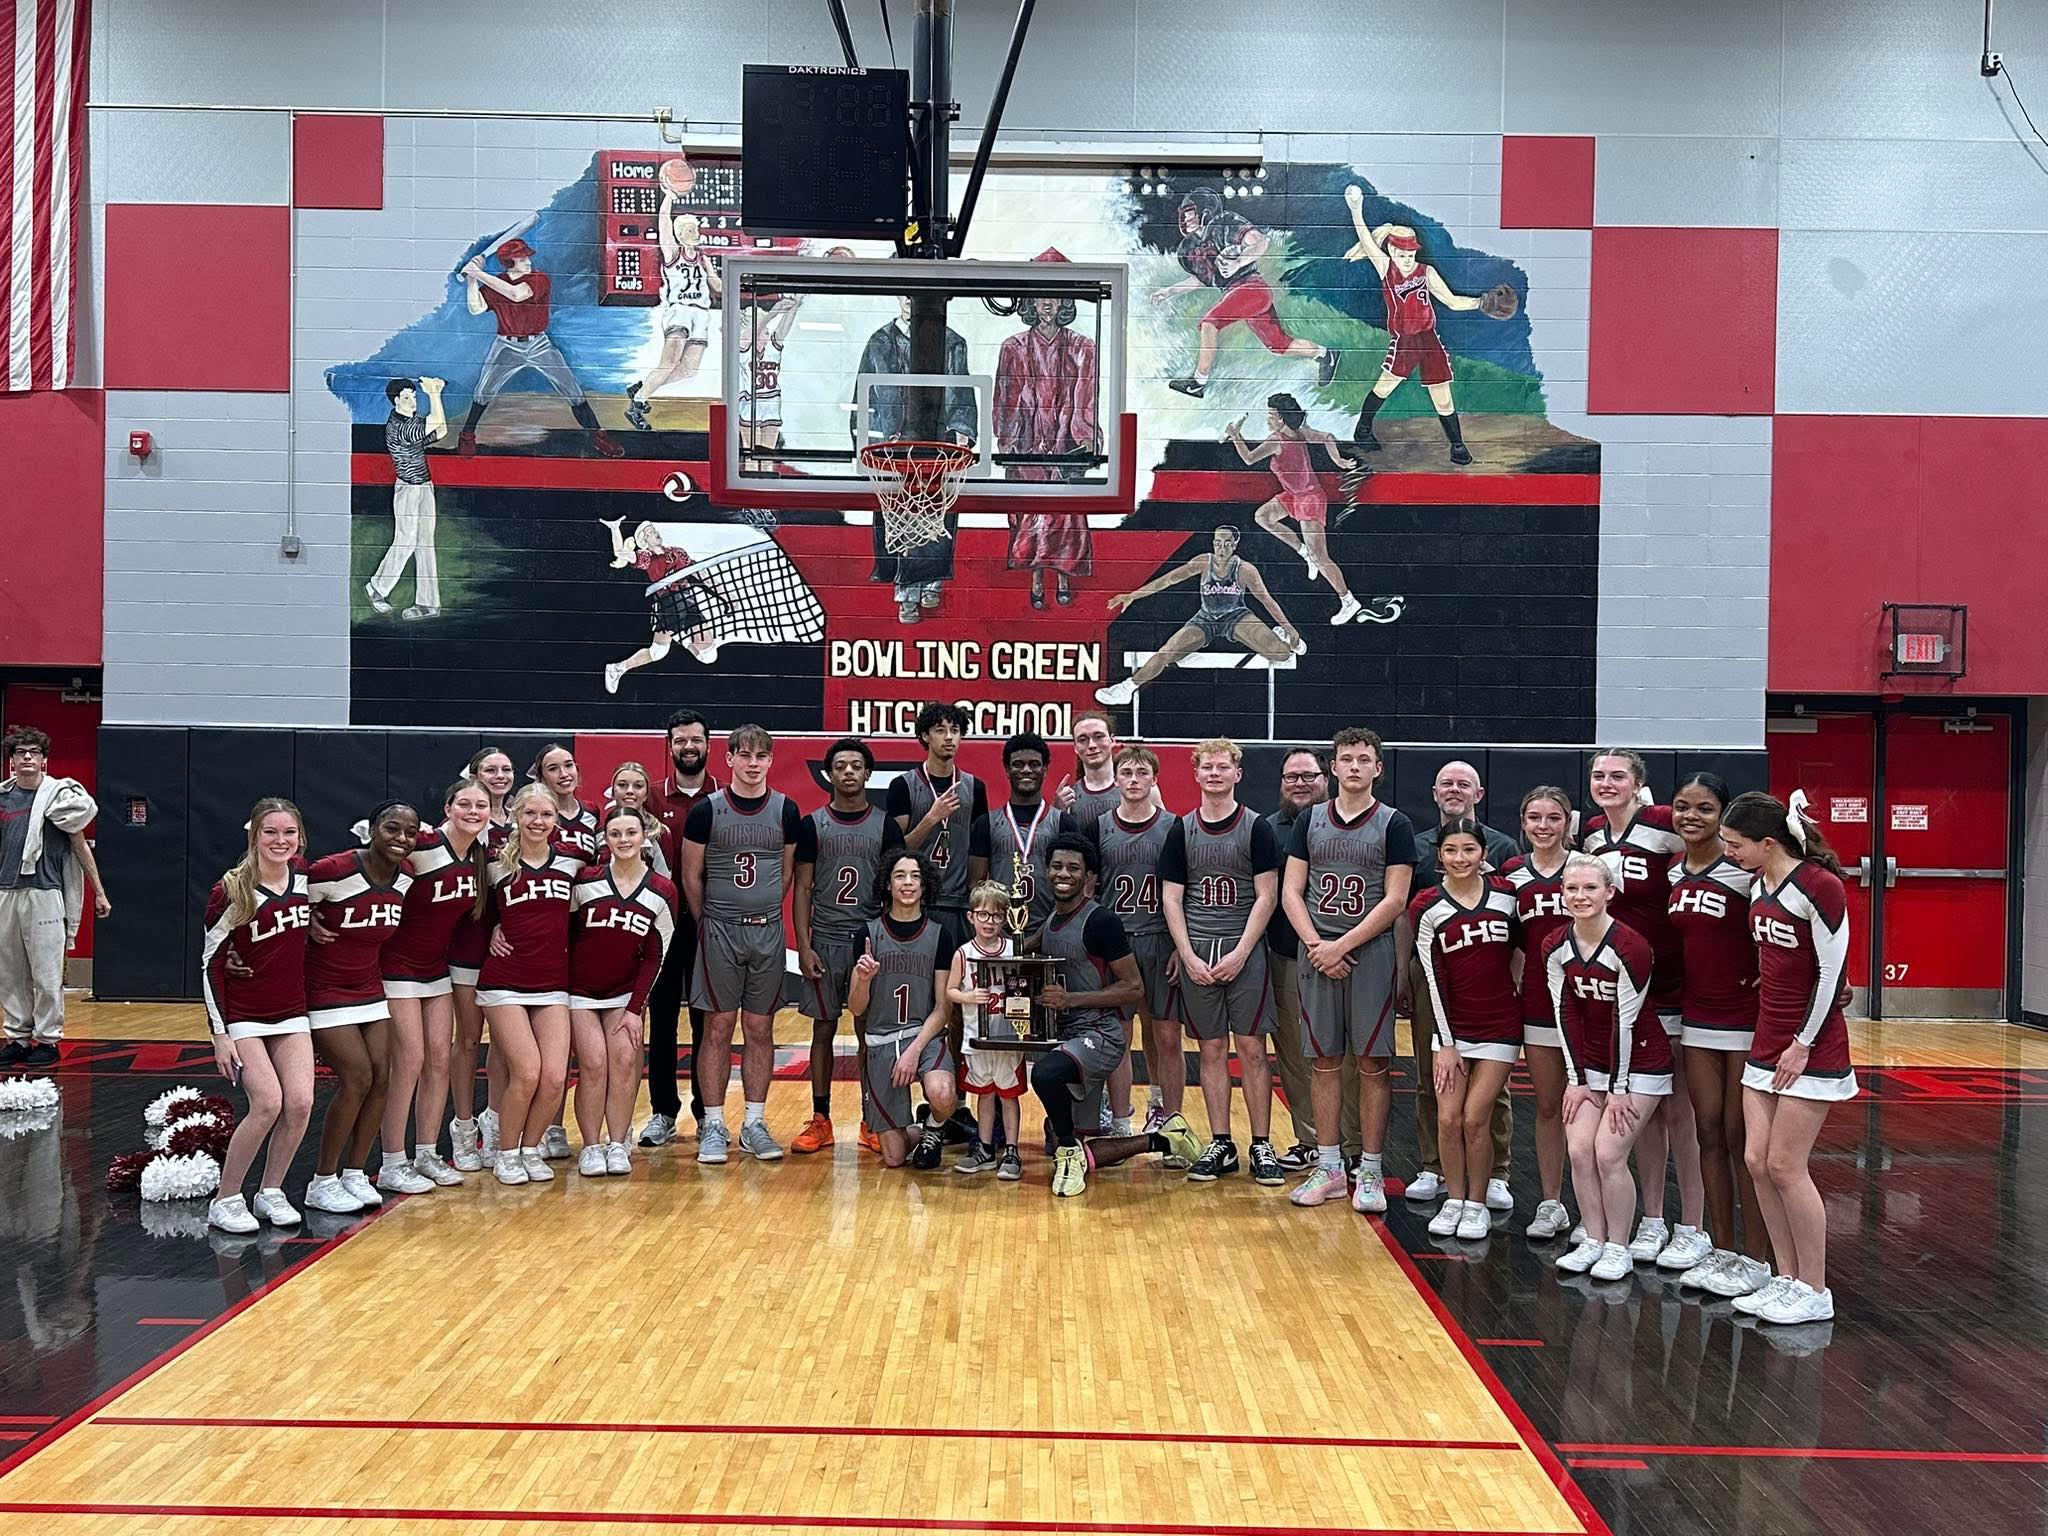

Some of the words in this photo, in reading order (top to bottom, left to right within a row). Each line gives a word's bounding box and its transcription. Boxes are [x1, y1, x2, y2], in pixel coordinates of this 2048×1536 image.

[788, 65, 867, 76] DAKTRONICS
[611, 162, 654, 179] Home
[700, 216, 710, 228] 2
[717, 216, 727, 229] 3
[615, 276, 643, 291] Fouls
[680, 265, 703, 293] 34
[1416, 289, 1429, 306] 9
[830, 639, 980, 679] BOWLING
[991, 641, 1100, 682] GREEN
[851, 700, 924, 737] HIG
[560, 830, 595, 856] HS
[929, 830, 950, 869] 4
[733, 852, 757, 889] 3
[431, 875, 478, 903] LH
[503, 878, 571, 907] LHS
[836, 866, 859, 906] 2
[1114, 873, 1159, 915] 24
[1199, 875, 1238, 907] 10
[1318, 872, 1366, 917] 23
[340, 903, 402, 929] LHS
[585, 907, 651, 937] LHS
[1439, 920, 1510, 954] LHS
[1752, 915, 1799, 949] HS
[1884, 963, 1910, 981] 37
[1573, 975, 1618, 1002] HS
[893, 983, 911, 1025] 1
